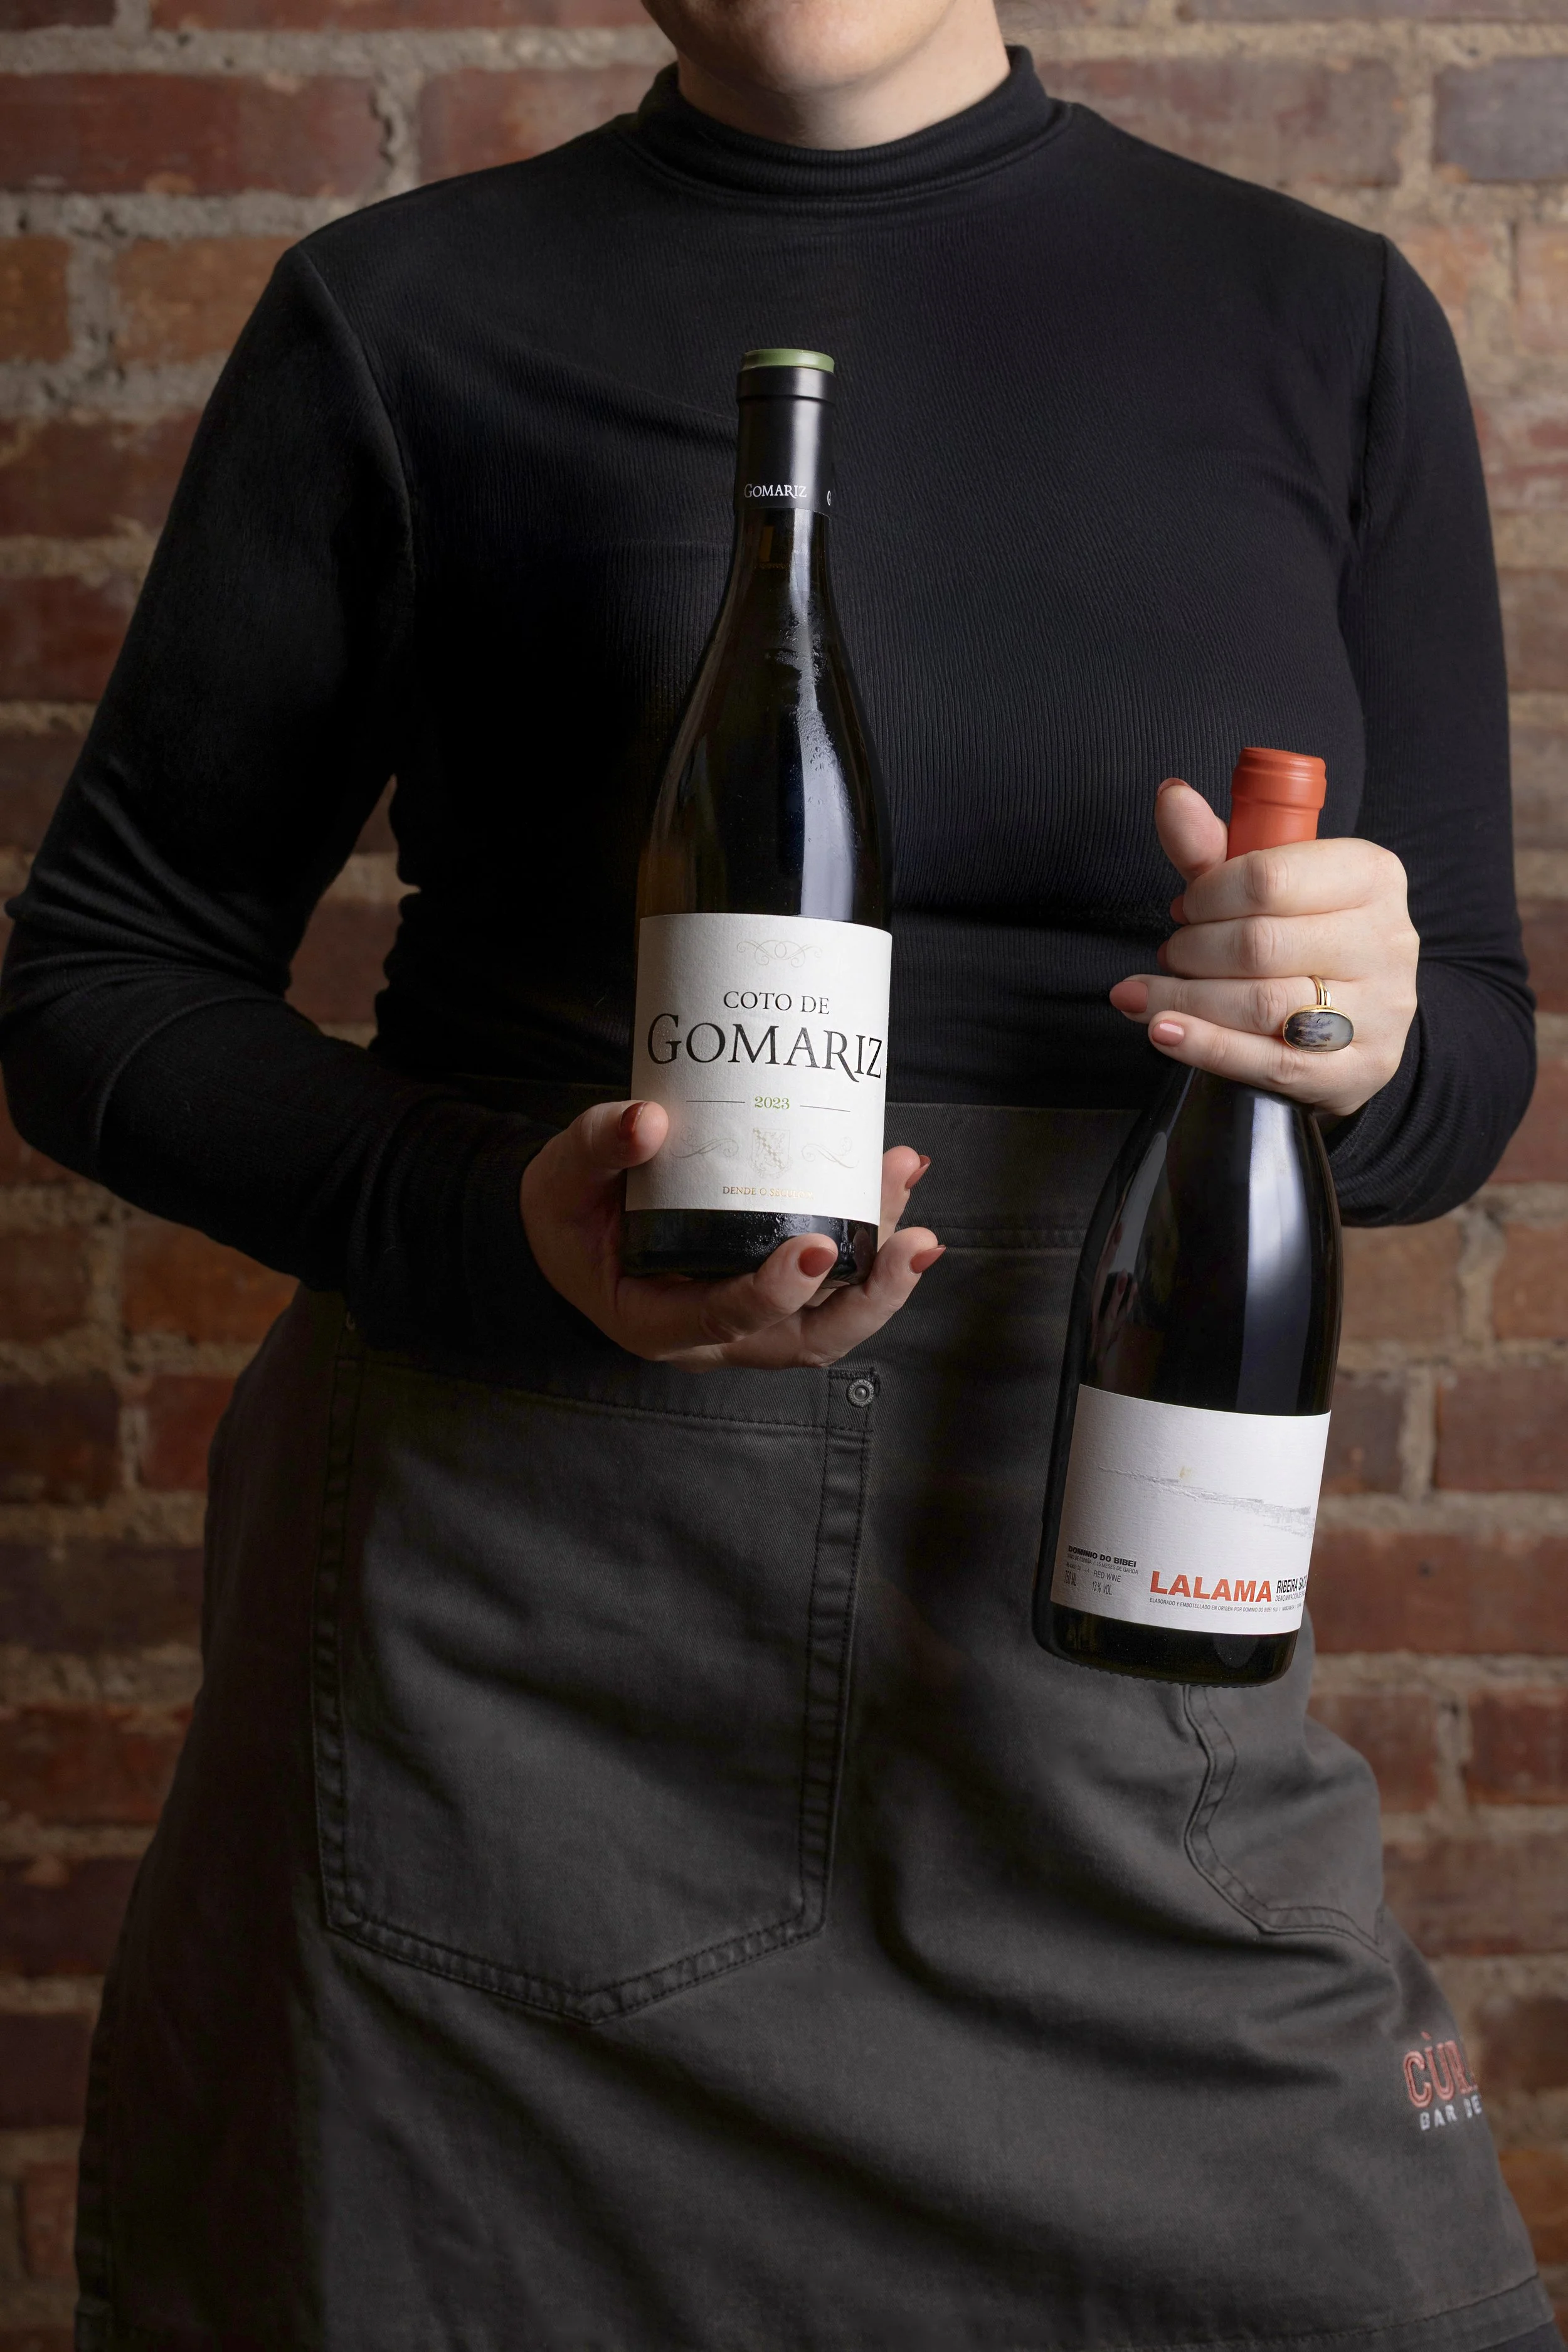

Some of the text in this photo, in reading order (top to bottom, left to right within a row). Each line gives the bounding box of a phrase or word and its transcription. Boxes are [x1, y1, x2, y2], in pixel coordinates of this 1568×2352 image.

[744, 484, 807, 499] GOMARIZ
[723, 991, 829, 1014] COTO DE
[647, 1013, 882, 1083] GOMARIZ
[755, 1096, 790, 1110] 2023
[723, 1186, 756, 1195] DENDE
[1068, 1545, 1136, 1567] DOMINIO DO BIBEI
[1093, 1570, 1121, 1582] RED WINE
[1150, 1571, 1272, 1602] LALAMA
[1276, 1578, 1298, 1594] RIBEIRA
[1150, 1597, 1175, 1606] ELABORADO
[1419, 2104, 1457, 2131] BAR
